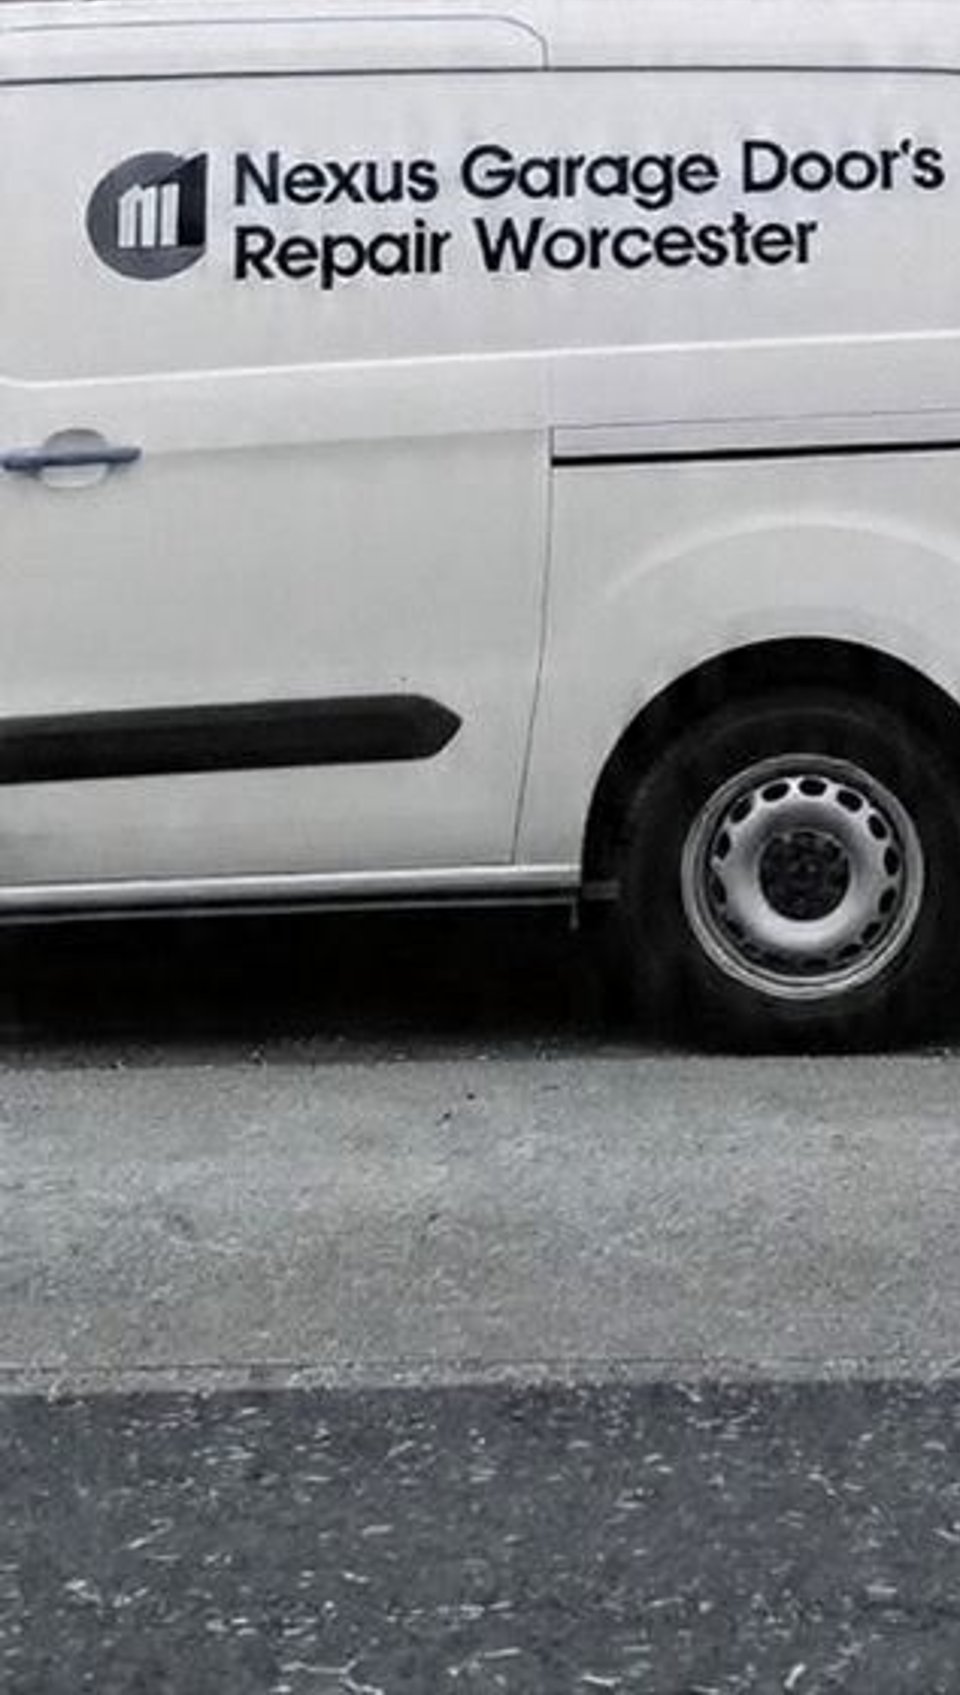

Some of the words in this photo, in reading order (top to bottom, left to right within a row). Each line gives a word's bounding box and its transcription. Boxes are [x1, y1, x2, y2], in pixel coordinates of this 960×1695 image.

[234, 151, 440, 206] Nexus
[460, 144, 720, 210] Garage
[742, 138, 947, 194] Door's
[233, 217, 453, 291] Repair
[473, 211, 818, 273] Worcester
